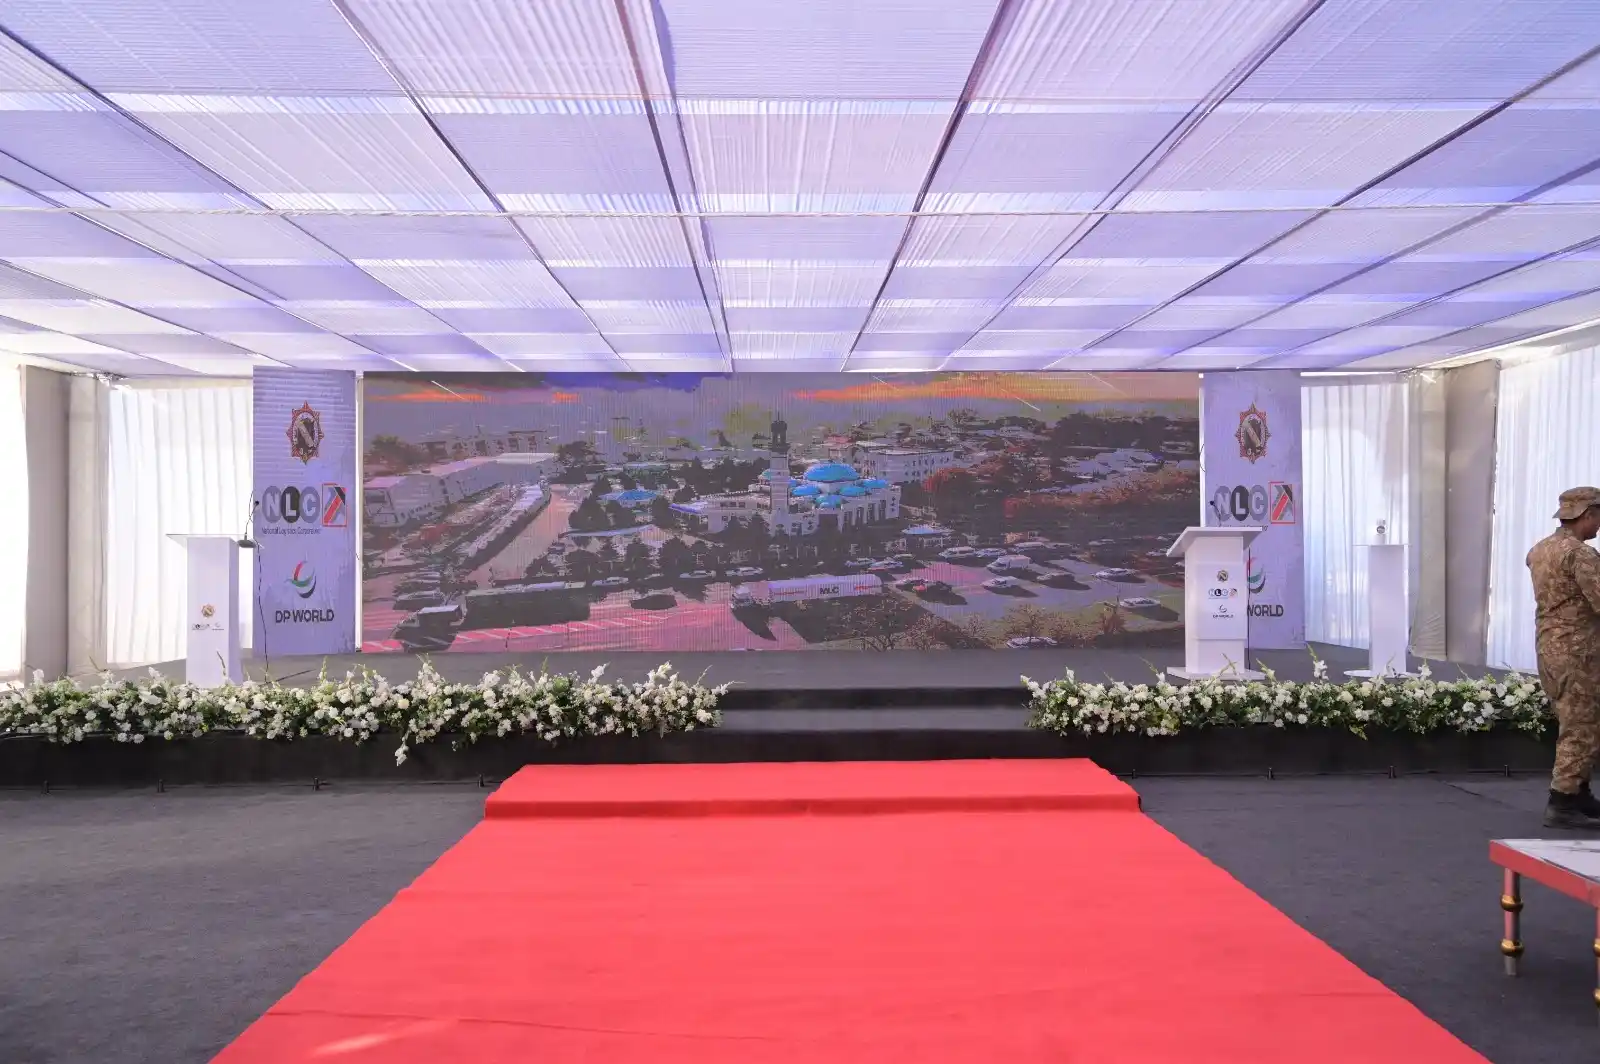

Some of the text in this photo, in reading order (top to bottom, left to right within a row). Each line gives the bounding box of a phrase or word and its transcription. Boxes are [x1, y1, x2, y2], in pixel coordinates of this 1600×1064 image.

[264, 491, 318, 518] NLC
[1215, 490, 1266, 516] NLC
[275, 609, 335, 624] DP WORLD
